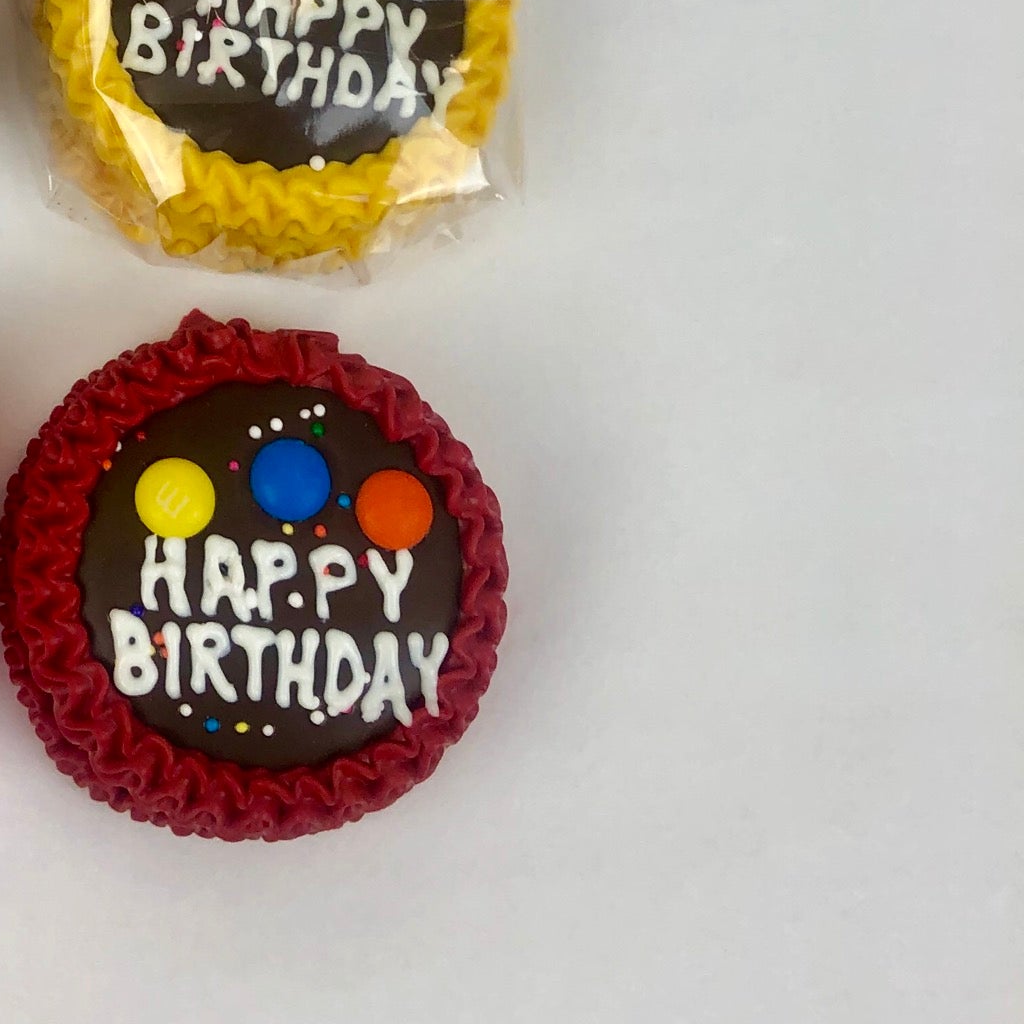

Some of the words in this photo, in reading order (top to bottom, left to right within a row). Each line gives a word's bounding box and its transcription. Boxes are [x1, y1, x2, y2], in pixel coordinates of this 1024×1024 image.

[121, 2, 466, 129] BIRTHDAY
[139, 534, 414, 623] HAPPY
[108, 609, 450, 727] BIRTHDAY
